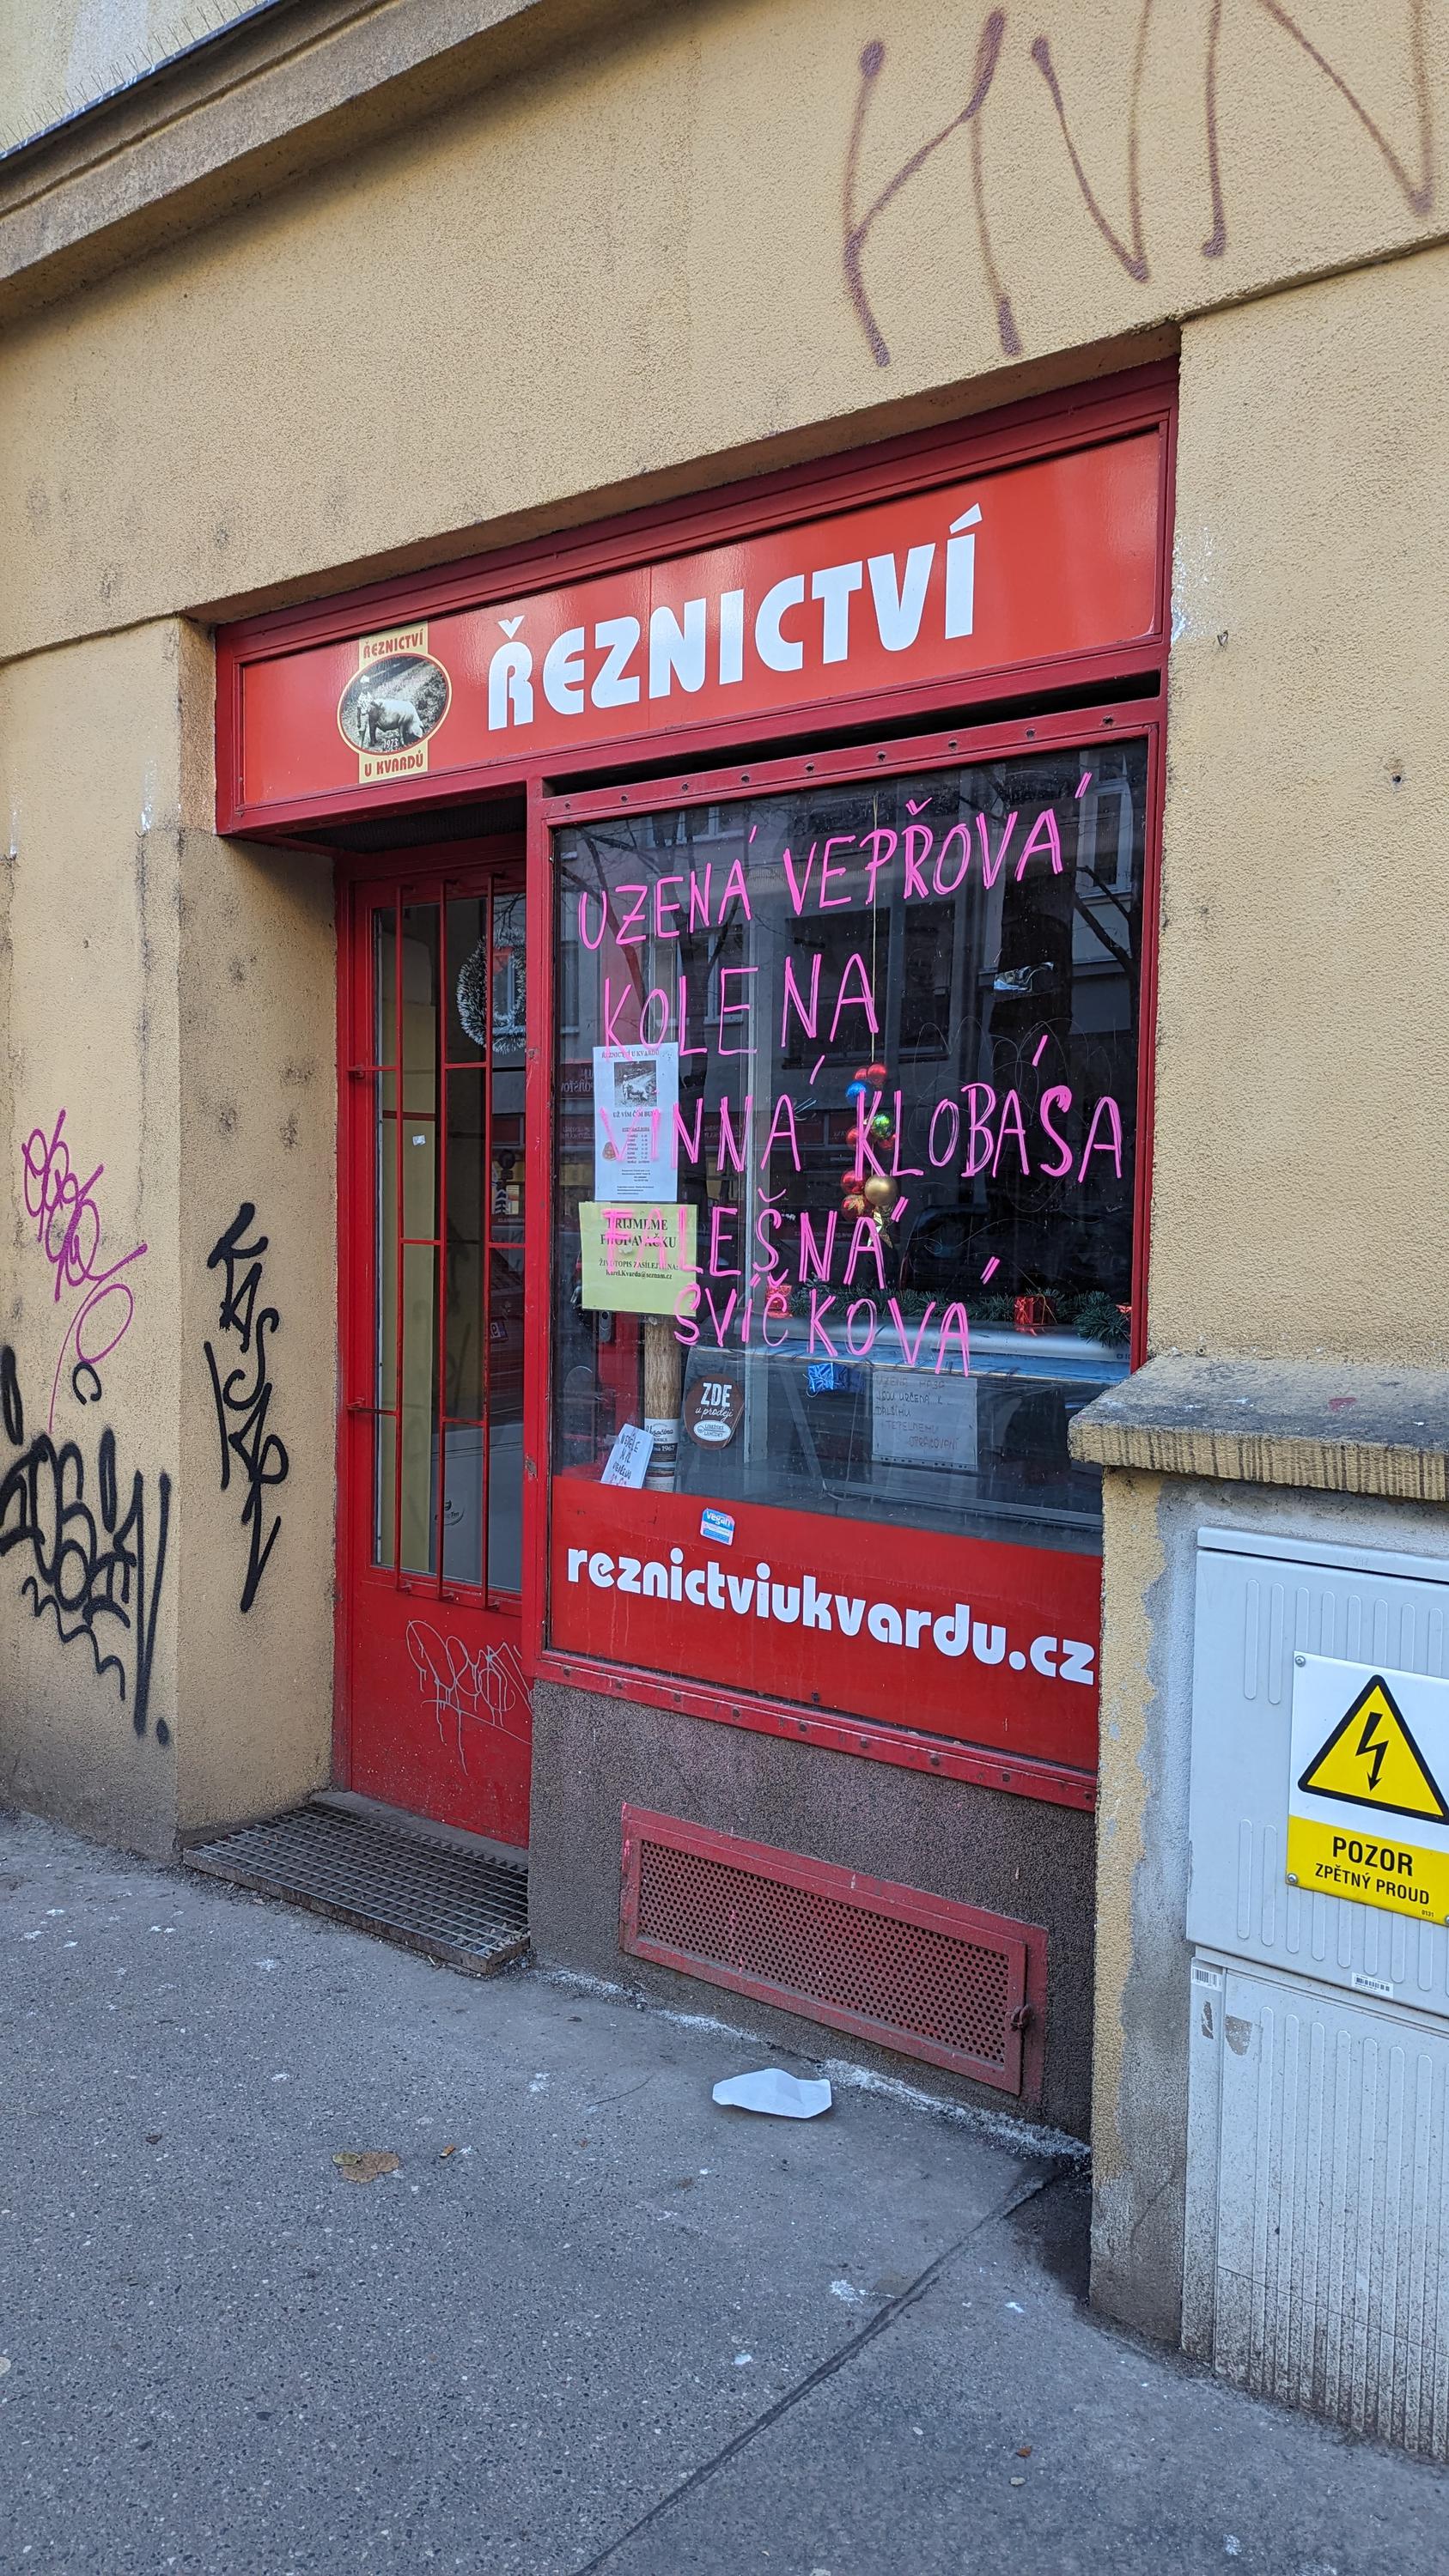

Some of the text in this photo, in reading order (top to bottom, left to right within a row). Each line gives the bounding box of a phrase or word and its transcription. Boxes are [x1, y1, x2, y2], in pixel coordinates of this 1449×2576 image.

[488, 502, 983, 731] ŘEZNICTVÍ
[363, 628, 424, 659] ŘEZNICTVÍ
[364, 750, 423, 777] U KVARDŮ
[578, 772, 1092, 950] UZENÁ VEPŘOVÁ
[600, 1035, 1122, 1183] VINNÁ KLOBÁSA
[600, 1188, 909, 1290] FALEŠNÁ
[674, 1256, 1000, 1377] SVÍČKOVÁ
[700, 1382, 733, 1407] ZDE
[701, 1406, 734, 1423] prodeji
[706, 1510, 731, 1526] vegan
[567, 1547, 1094, 1686] reznictviukvardu.cz
[1332, 1836, 1413, 1877] POZOR
[1315, 1862, 1430, 1905] ZPĚTNÝ PROUD
